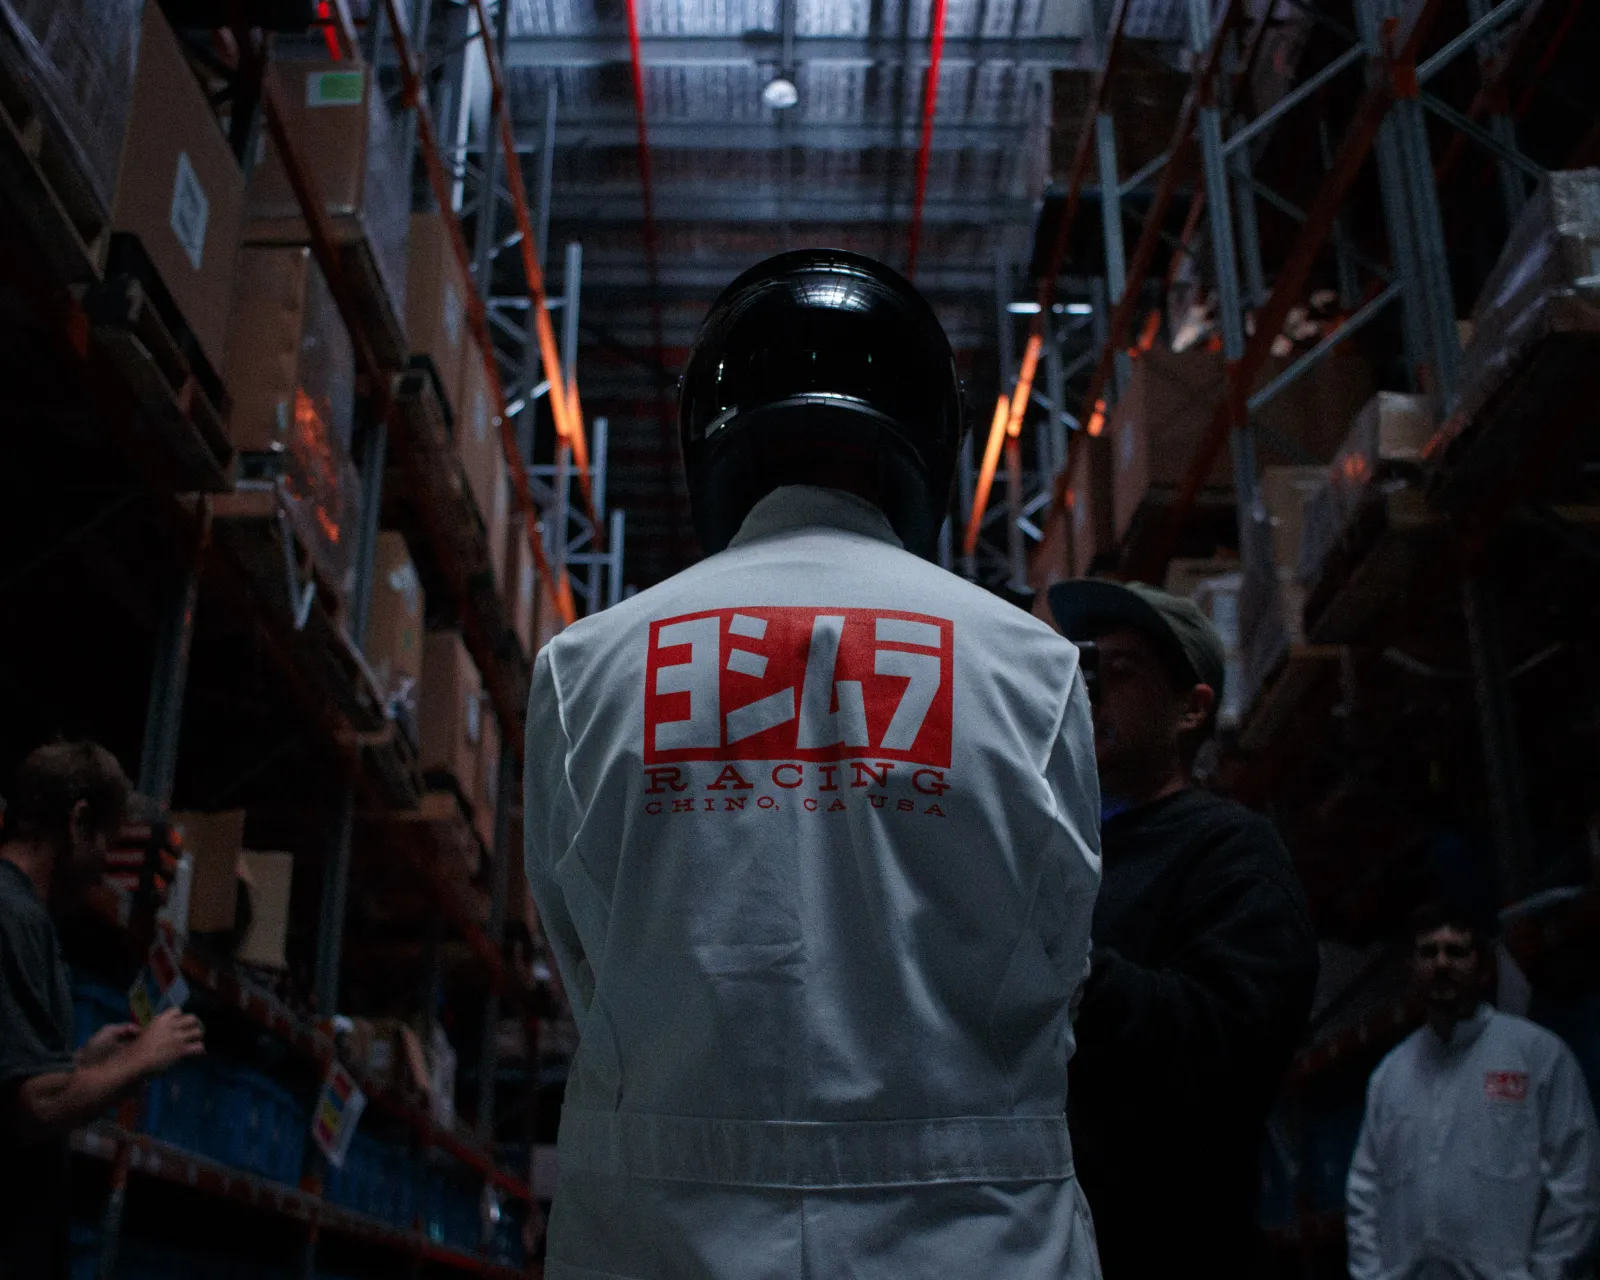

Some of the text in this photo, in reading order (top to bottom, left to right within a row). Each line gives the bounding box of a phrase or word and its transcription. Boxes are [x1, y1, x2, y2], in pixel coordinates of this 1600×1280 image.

[654, 613, 942, 751] ヨシムラ
[644, 762, 950, 796] RACING
[645, 794, 946, 817] CHINO, CA USA
